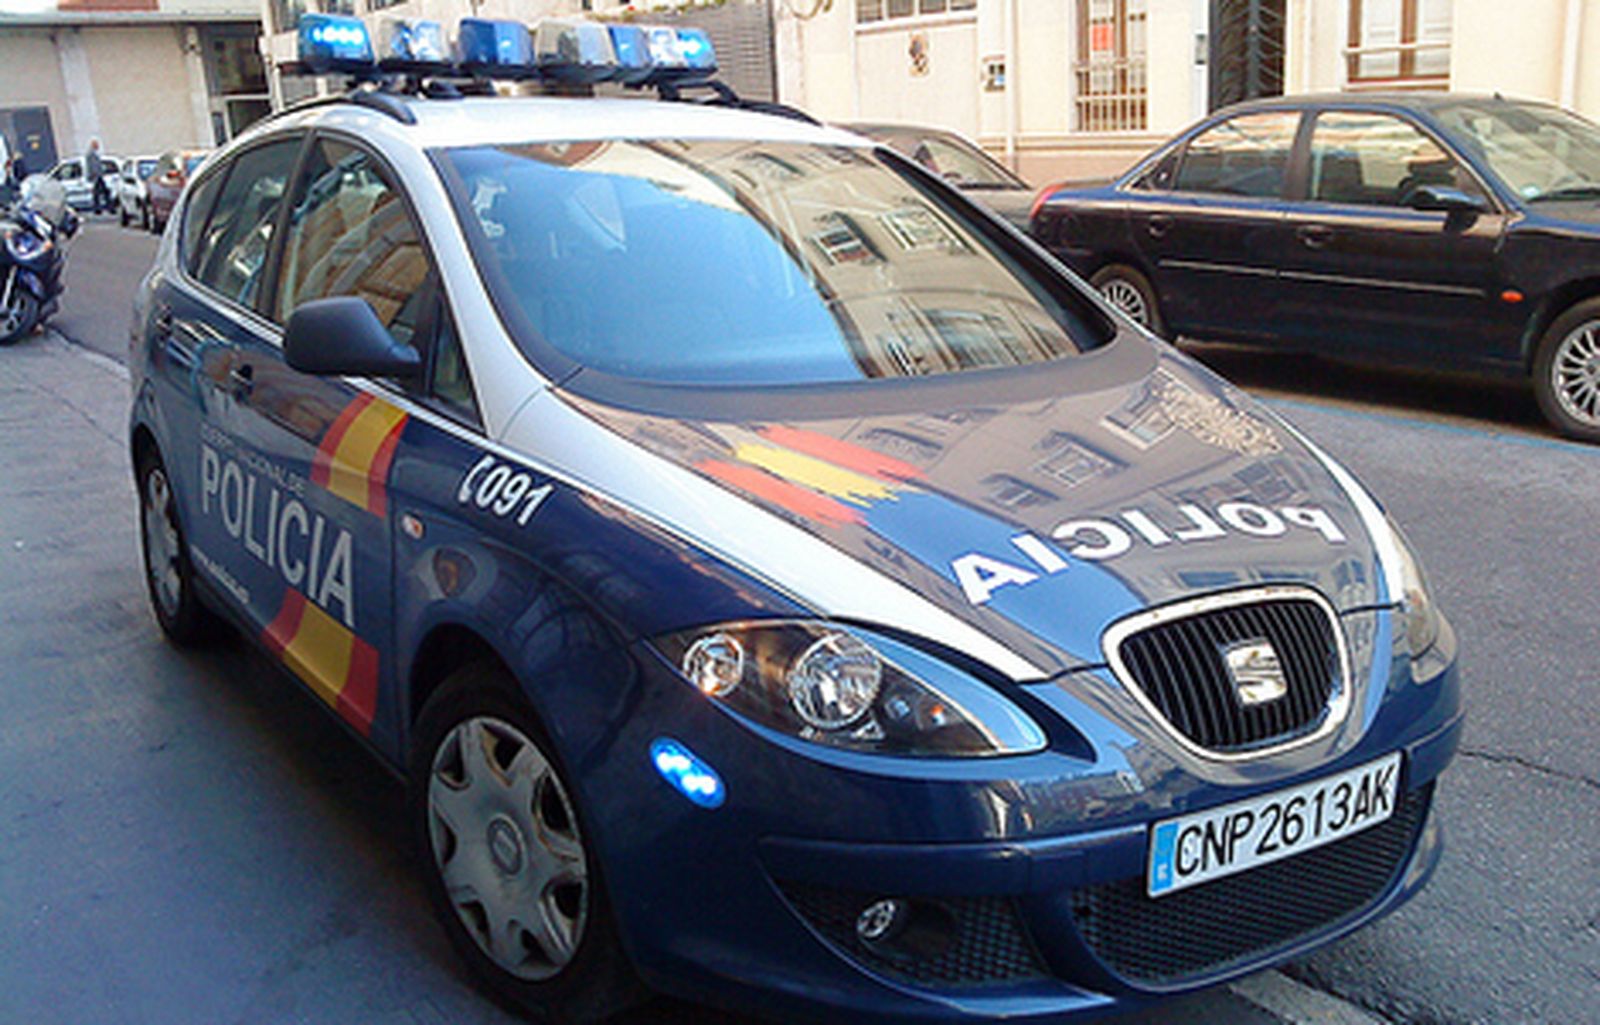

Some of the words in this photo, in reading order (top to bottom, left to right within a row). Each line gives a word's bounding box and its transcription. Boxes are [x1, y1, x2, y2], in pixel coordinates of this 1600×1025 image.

[201, 444, 356, 629] POLICIA
[476, 464, 555, 526] 091
[1175, 764, 1396, 877] CNP2613AK
